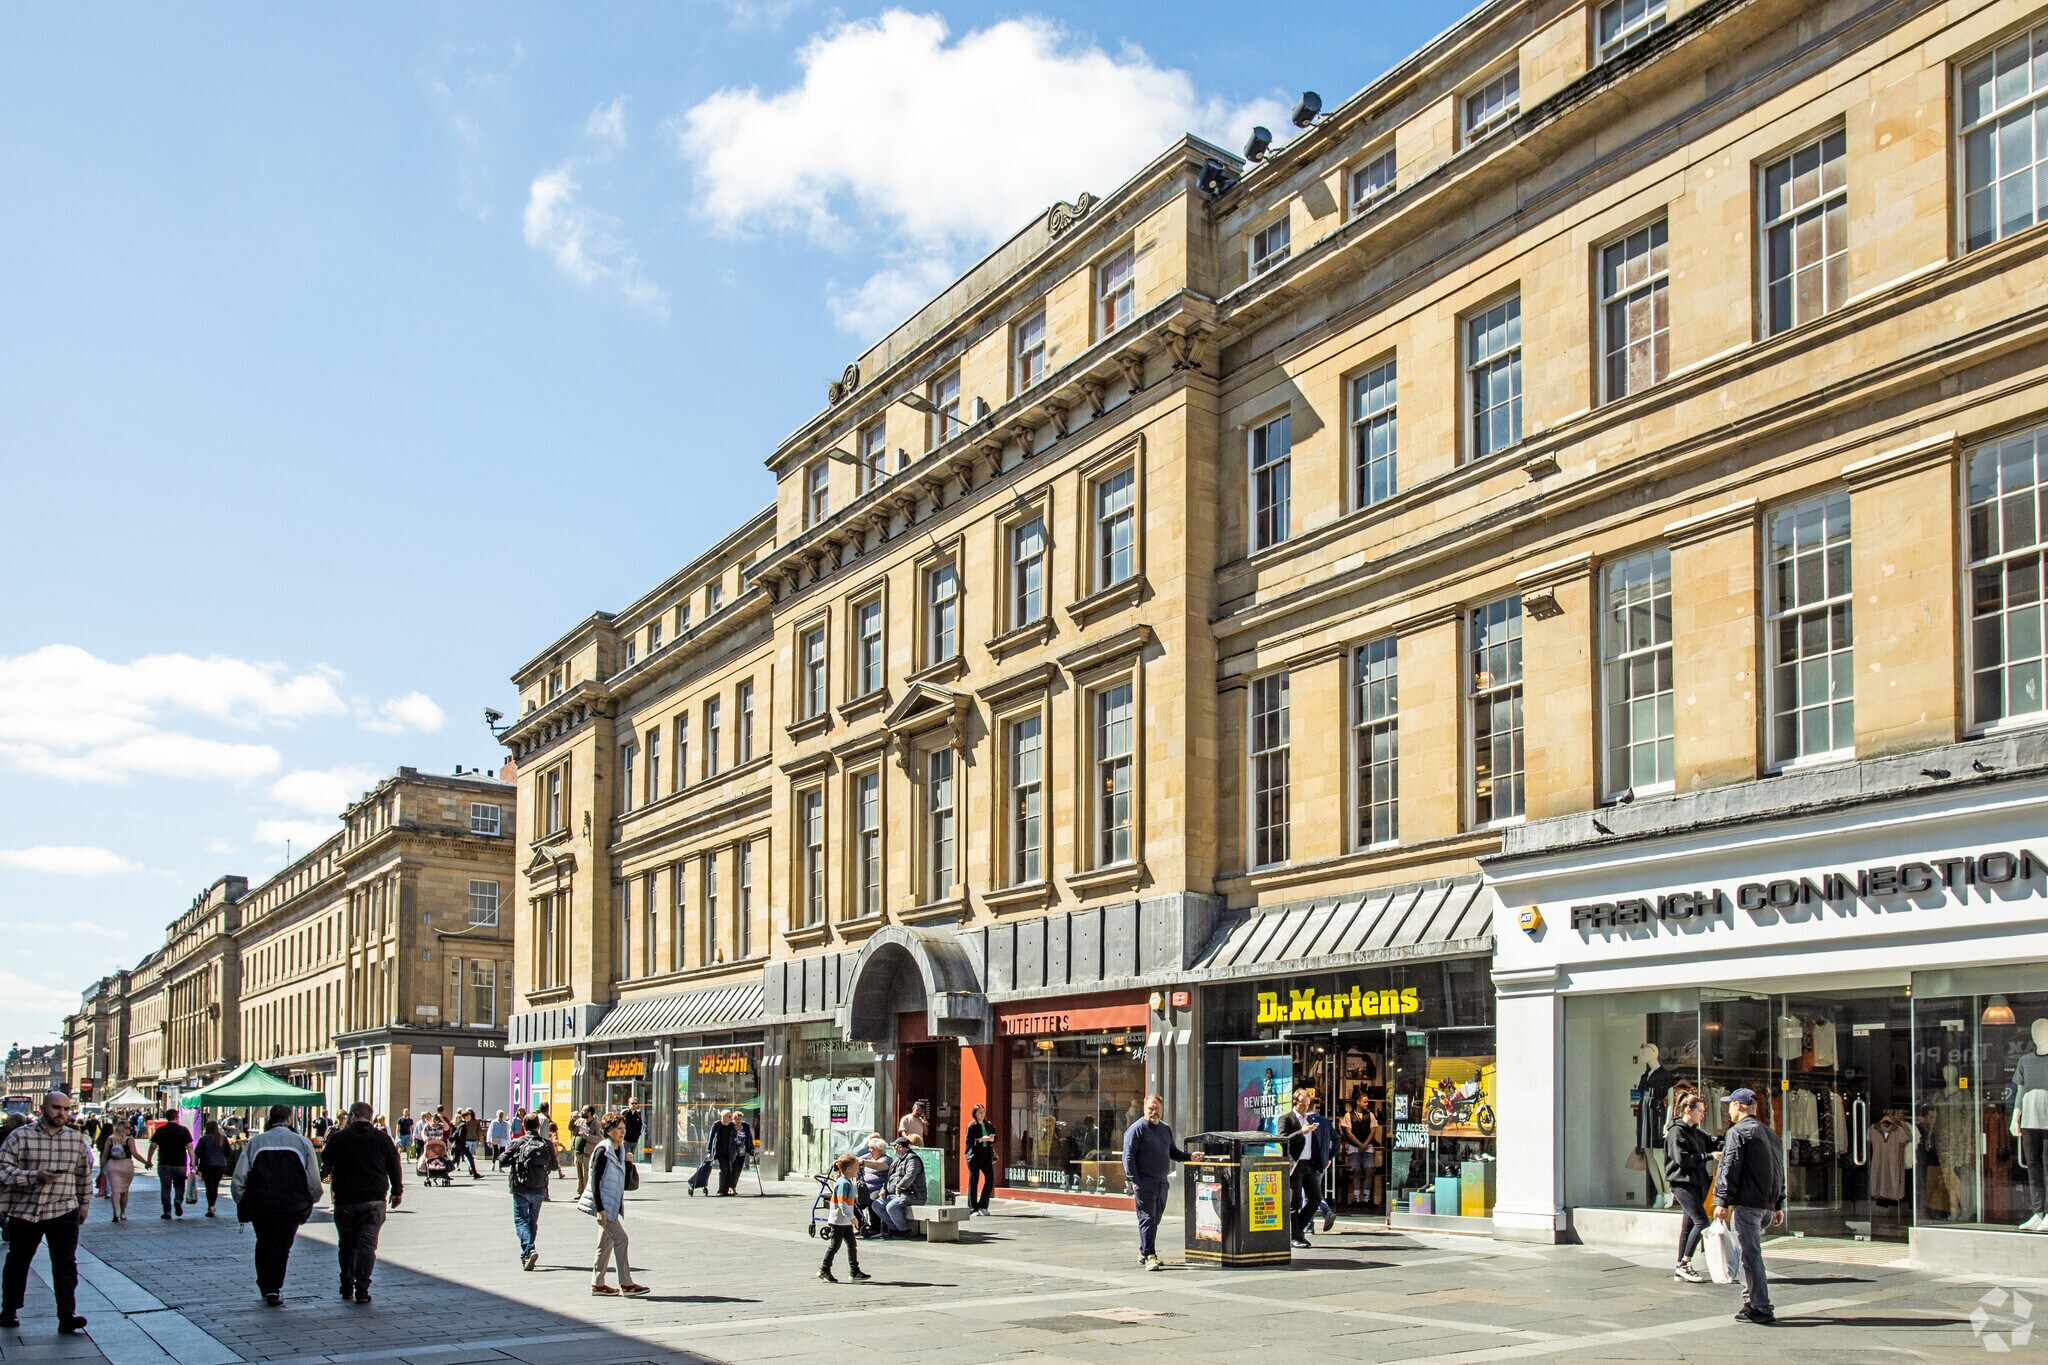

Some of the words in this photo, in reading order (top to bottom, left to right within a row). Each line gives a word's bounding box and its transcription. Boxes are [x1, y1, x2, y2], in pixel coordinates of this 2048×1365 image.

[1571, 889, 1721, 929] FRENCH
[1737, 849, 2048, 910] CONNECTION
[478, 1040, 497, 1048] END.
[1244, 1095, 1277, 1108] REWRITE
[1397, 1123, 1406, 1132] ALL
[1408, 1123, 1429, 1133] ACCESS
[1396, 1132, 1430, 1149] SUMMER
[1005, 1168, 1026, 1181] URBAN
[1254, 1174, 1277, 1183] STREET
[1254, 1183, 1278, 1196] ZERO
